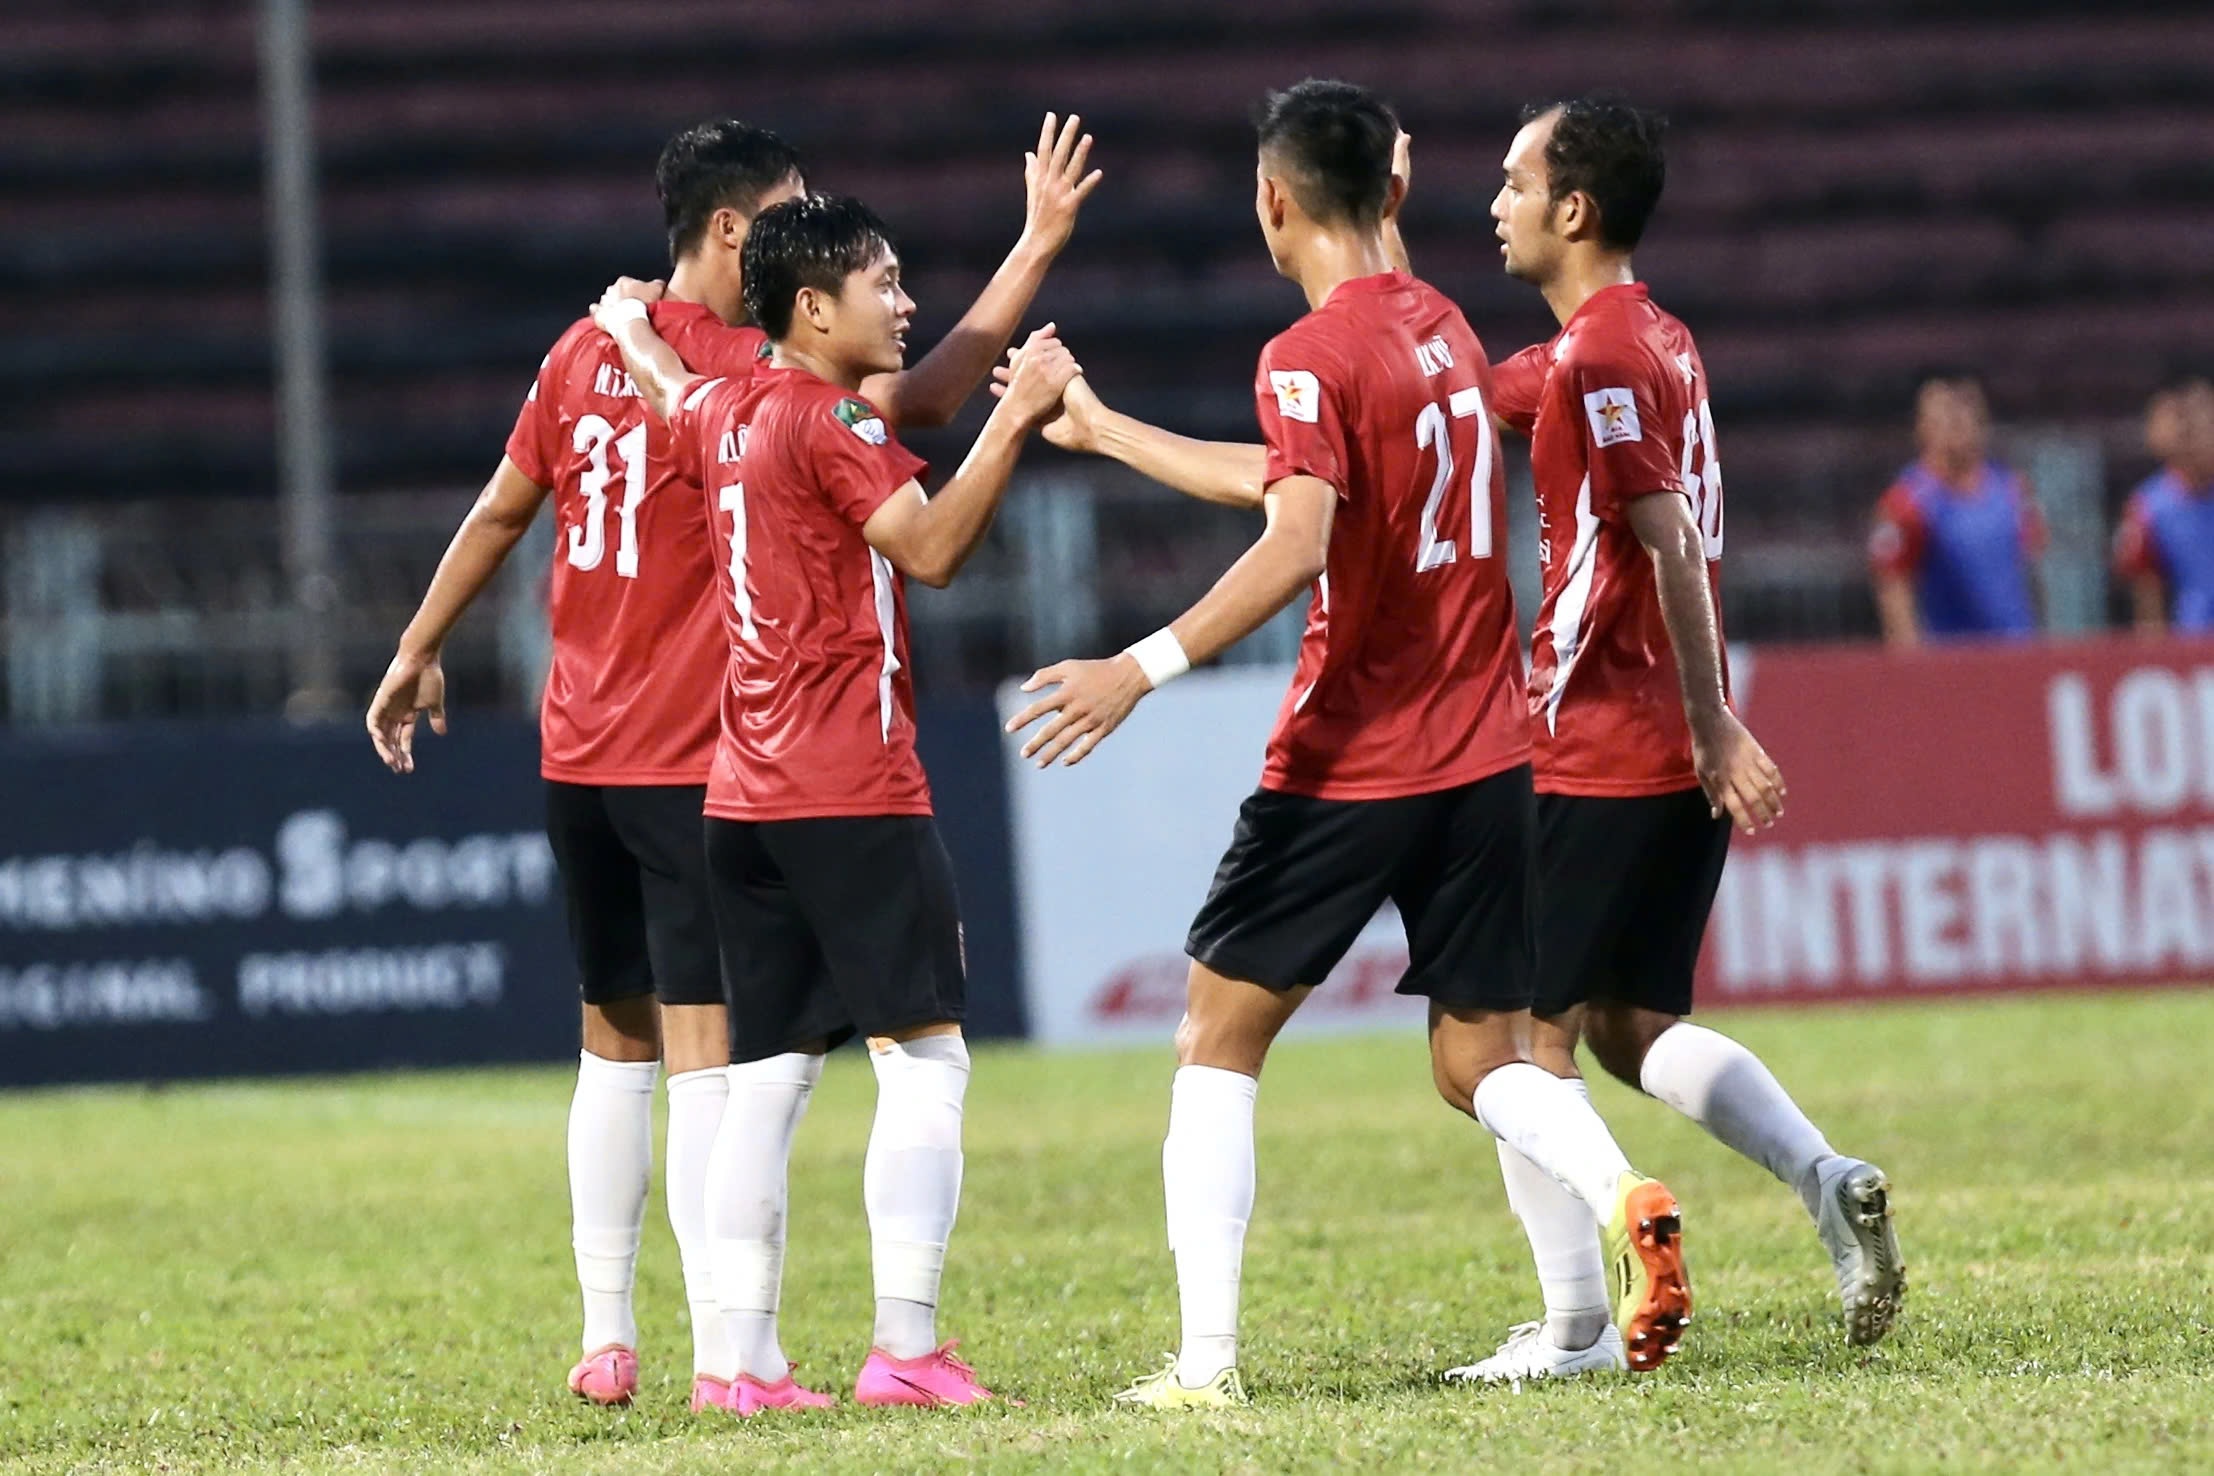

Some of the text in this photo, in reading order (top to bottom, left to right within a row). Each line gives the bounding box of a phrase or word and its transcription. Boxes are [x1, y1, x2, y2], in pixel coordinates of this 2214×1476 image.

[568, 414, 648, 578] 31
[1416, 386, 1493, 573] 27
[2047, 669, 2214, 817] LO
